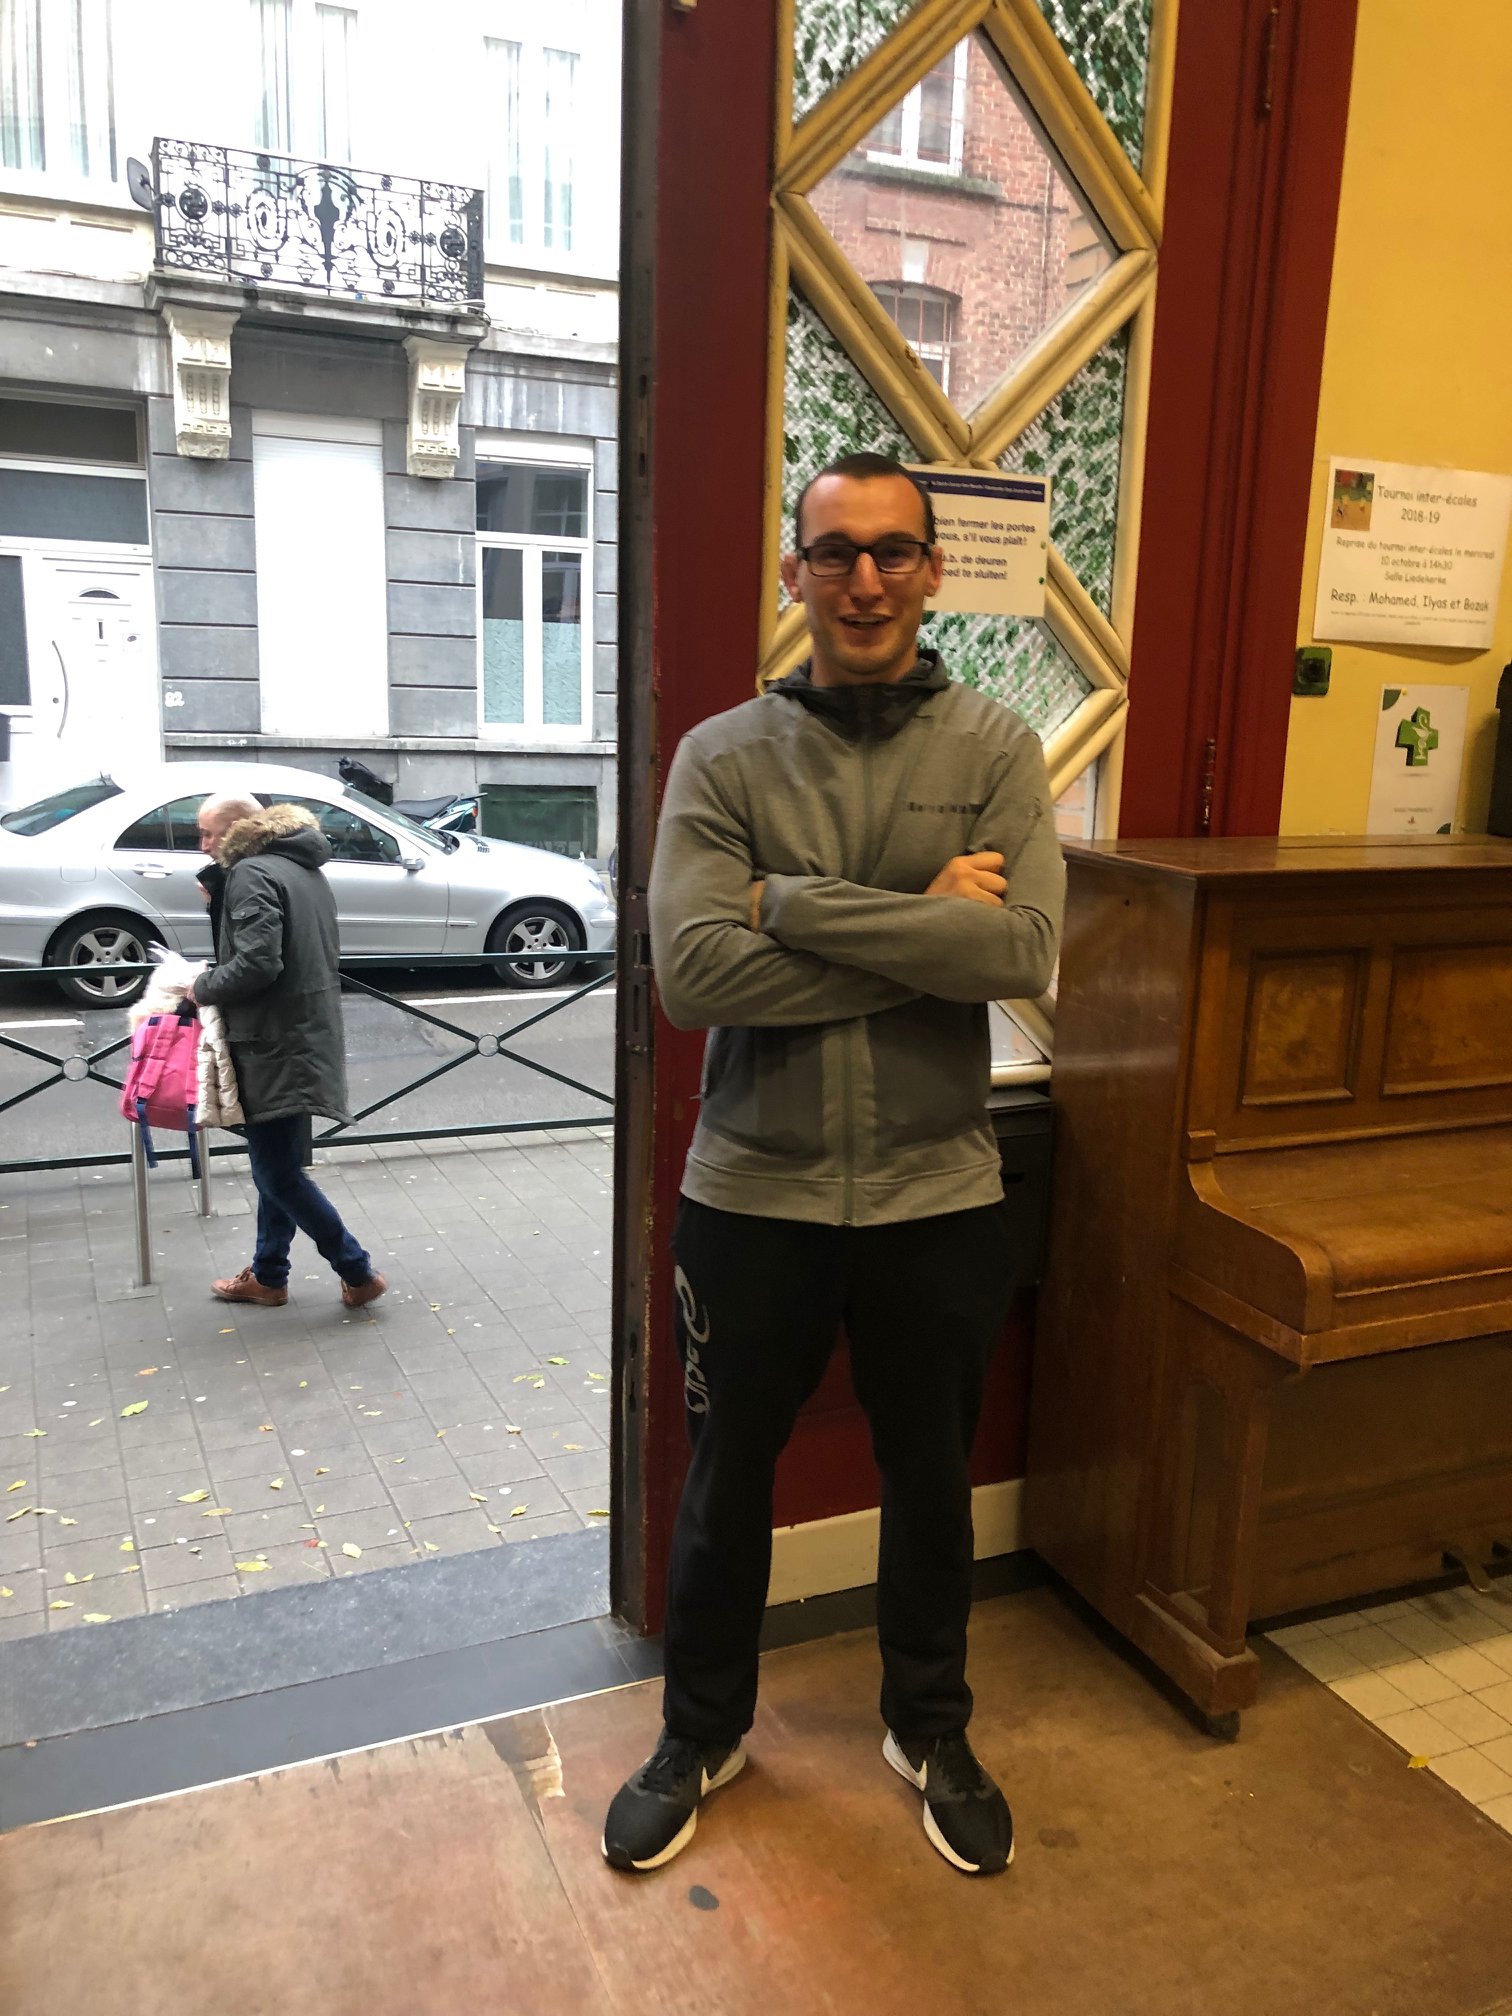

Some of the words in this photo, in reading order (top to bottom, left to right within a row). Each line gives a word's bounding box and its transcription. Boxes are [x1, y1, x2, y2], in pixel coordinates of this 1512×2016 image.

[1377, 485, 1414, 500] Tournoi
[1416, 490, 1477, 508] inter-écoles
[1400, 508, 1441, 524] 2018-19
[957, 517, 989, 530] fermer
[990, 520, 1004, 531] les
[1006, 522, 1036, 534] portes
[979, 535, 1001, 545] vous
[960, 554, 973, 564] de
[975, 555, 1008, 567] deuren
[1450, 598, 1461, 610] et
